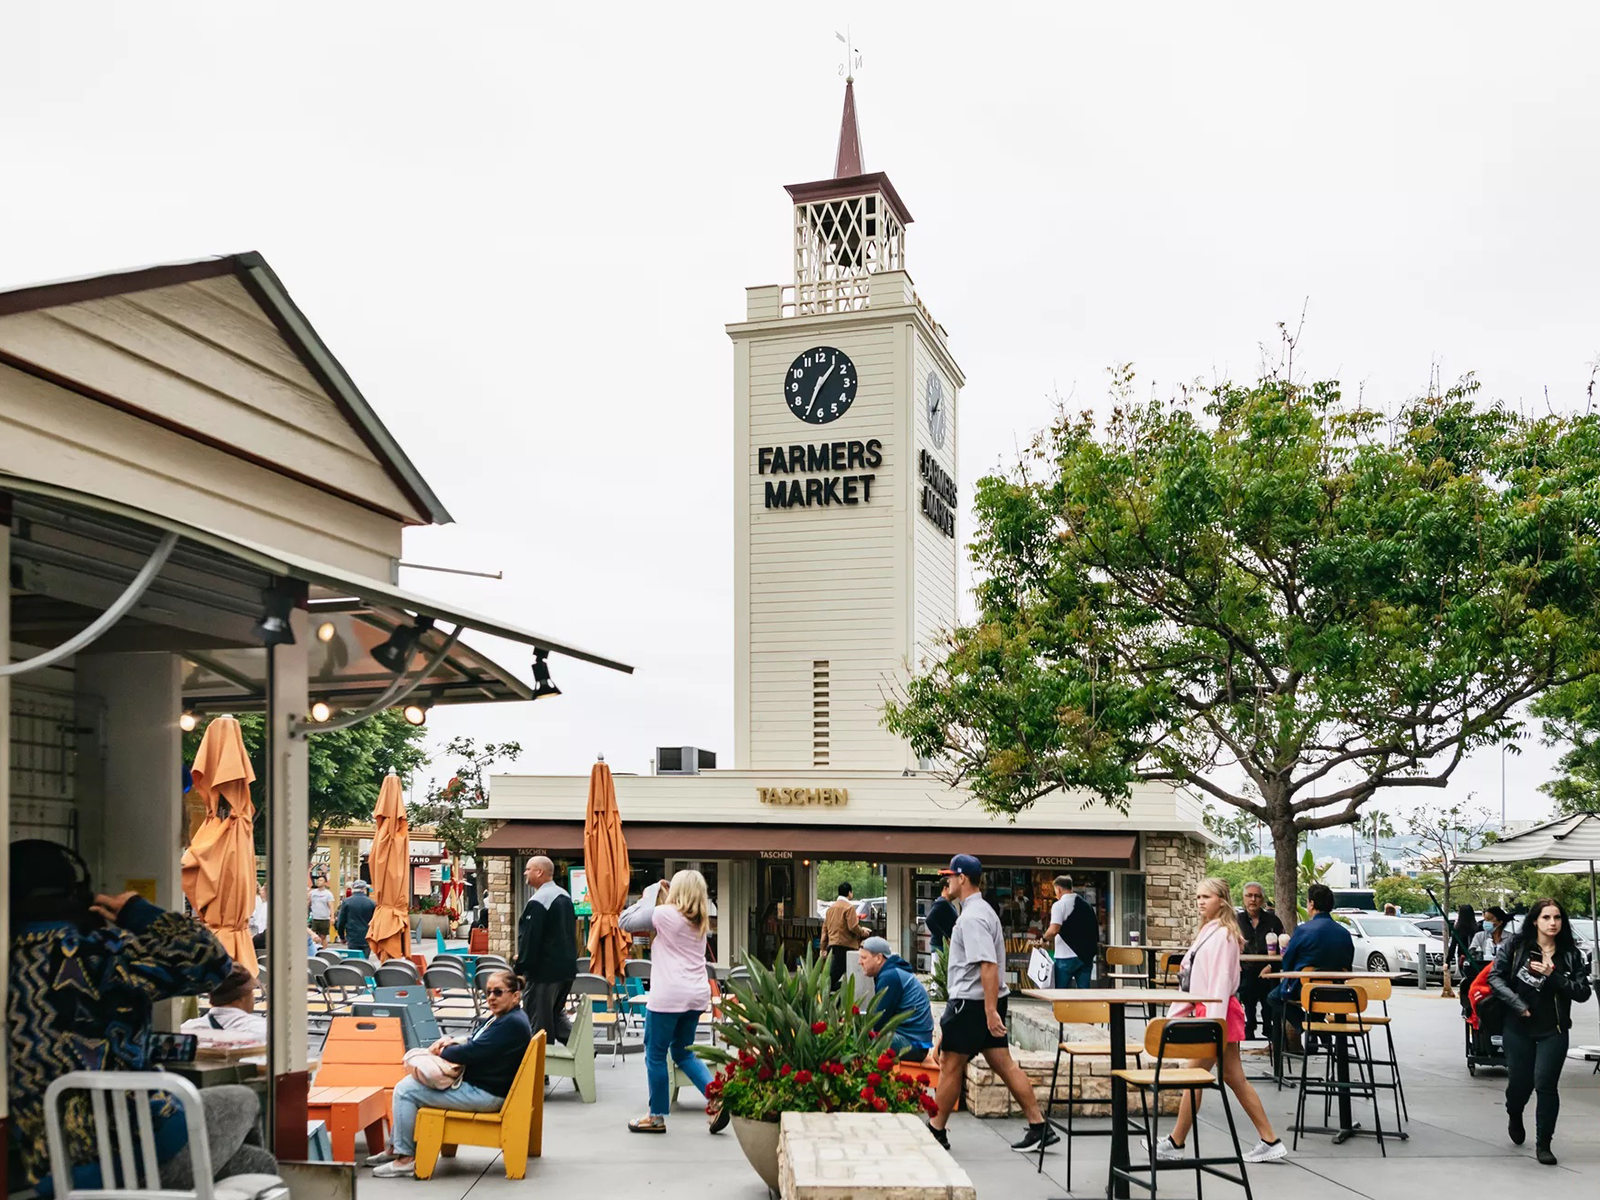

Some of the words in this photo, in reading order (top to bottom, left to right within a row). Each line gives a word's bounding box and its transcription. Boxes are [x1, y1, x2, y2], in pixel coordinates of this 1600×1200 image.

[805, 358, 811, 367] 11
[815, 353, 826, 363] 12
[832, 355, 835, 365] 1
[794, 369, 803, 378] 10
[840, 365, 846, 374] 2
[844, 378, 850, 387] 3
[792, 383, 798, 392] 9
[795, 396, 802, 406] 8
[839, 393, 846, 402] 4
[831, 403, 837, 413] 5
[817, 408, 824, 418] 6
[758, 439, 882, 475] FARMERS
[765, 474, 875, 508] MARKET
[756, 787, 848, 806] TASCHEN
[518, 848, 547, 856] TASCHEN
[760, 851, 793, 859] TASCHEN
[1036, 856, 1073, 865] TASCHEN
